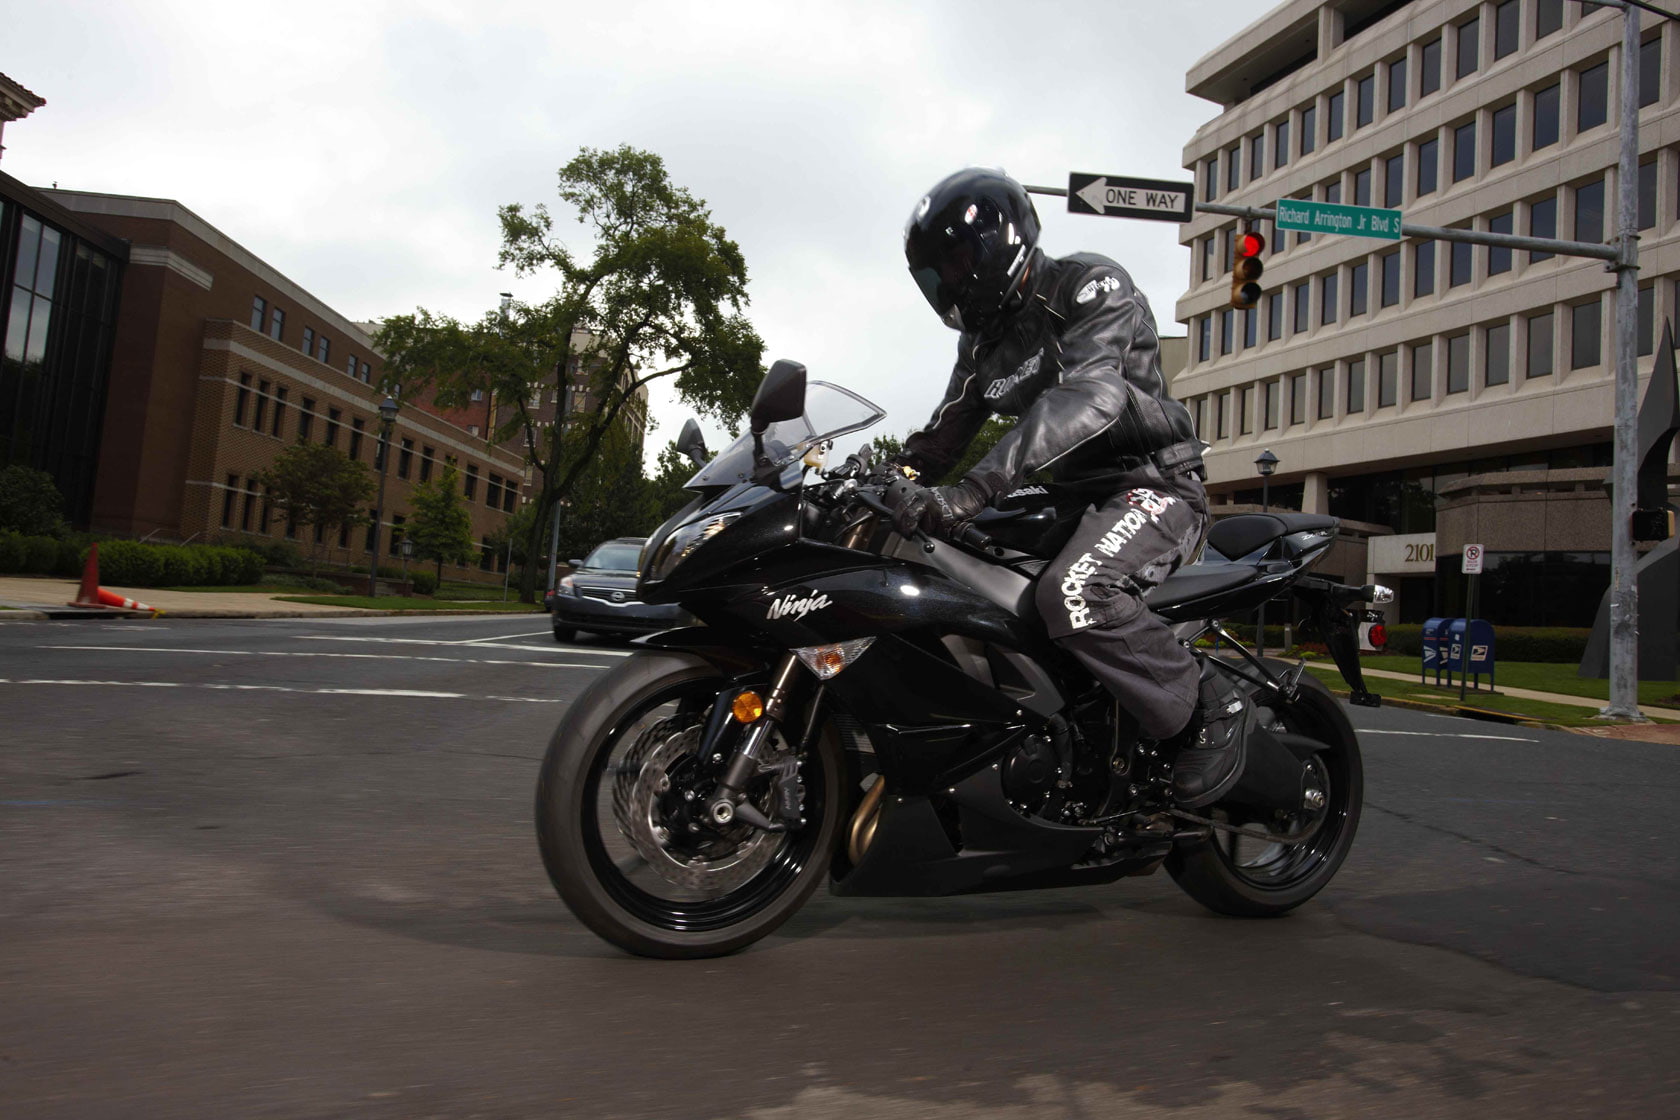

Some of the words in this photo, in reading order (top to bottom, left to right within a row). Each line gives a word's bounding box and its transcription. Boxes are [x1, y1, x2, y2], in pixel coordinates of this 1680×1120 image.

[1105, 188, 1137, 206] ONE
[1145, 192, 1179, 209] WAY
[1279, 206, 1310, 224] Richard
[1314, 210, 1353, 232] Arrington
[1357, 213, 1367, 230] Jr
[1371, 215, 1389, 233] Blvd
[1393, 217, 1400, 233] S
[1404, 543, 1435, 562] 2101
[1061, 553, 1103, 630] ROCKET
[1094, 508, 1147, 557] NATION
[766, 589, 833, 622] Ninja
